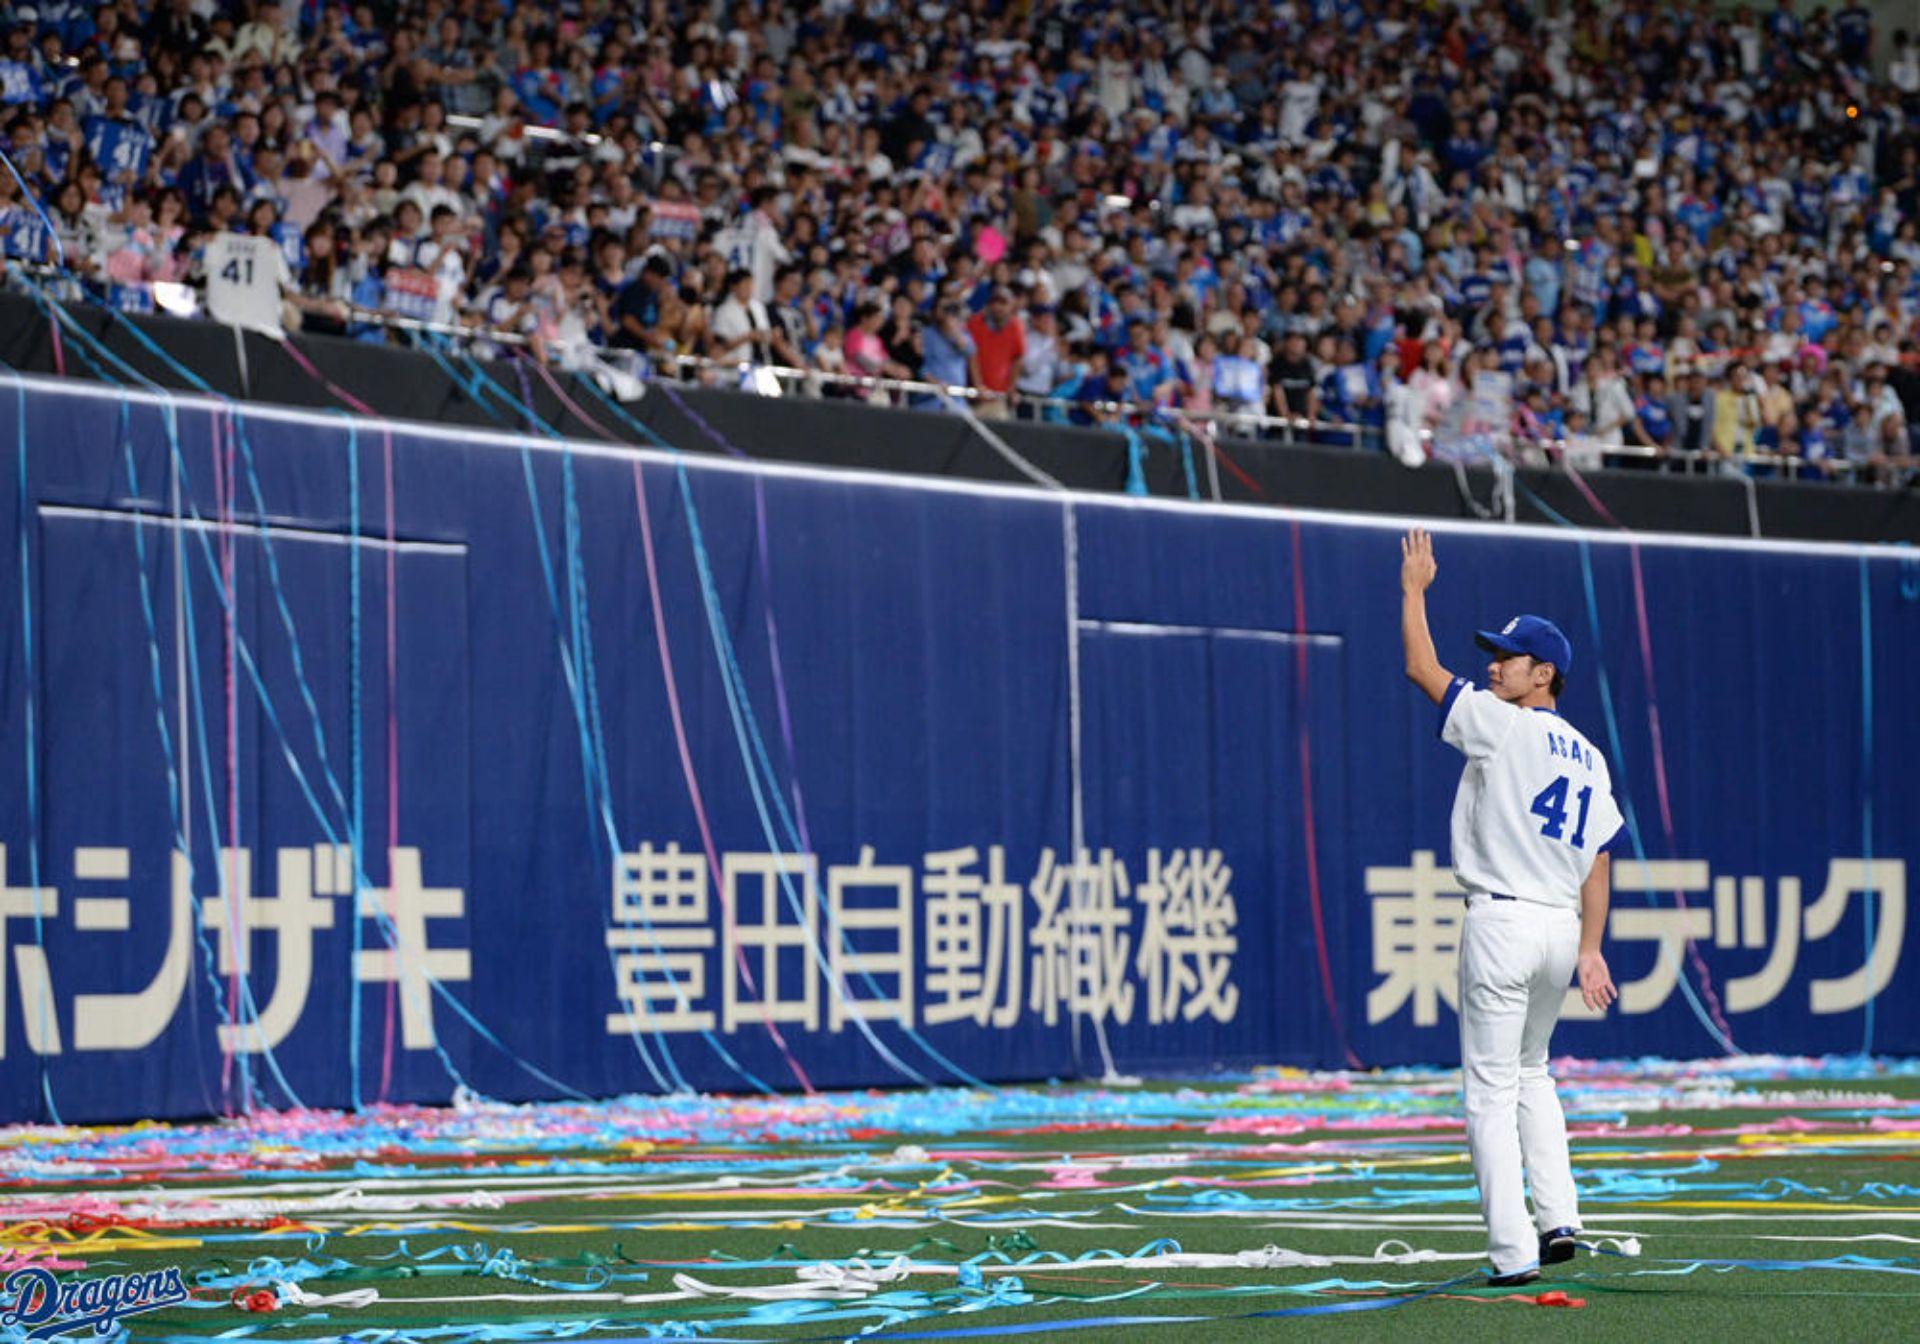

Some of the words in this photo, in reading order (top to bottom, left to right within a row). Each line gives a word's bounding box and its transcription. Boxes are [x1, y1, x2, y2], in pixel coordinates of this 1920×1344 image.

[13, 226, 42, 254] 41
[221, 257, 253, 286] 41
[1530, 775, 1592, 849] 41
[605, 841, 1240, 1034] 豊田自動織機
[1364, 850, 1907, 1027] 東テック
